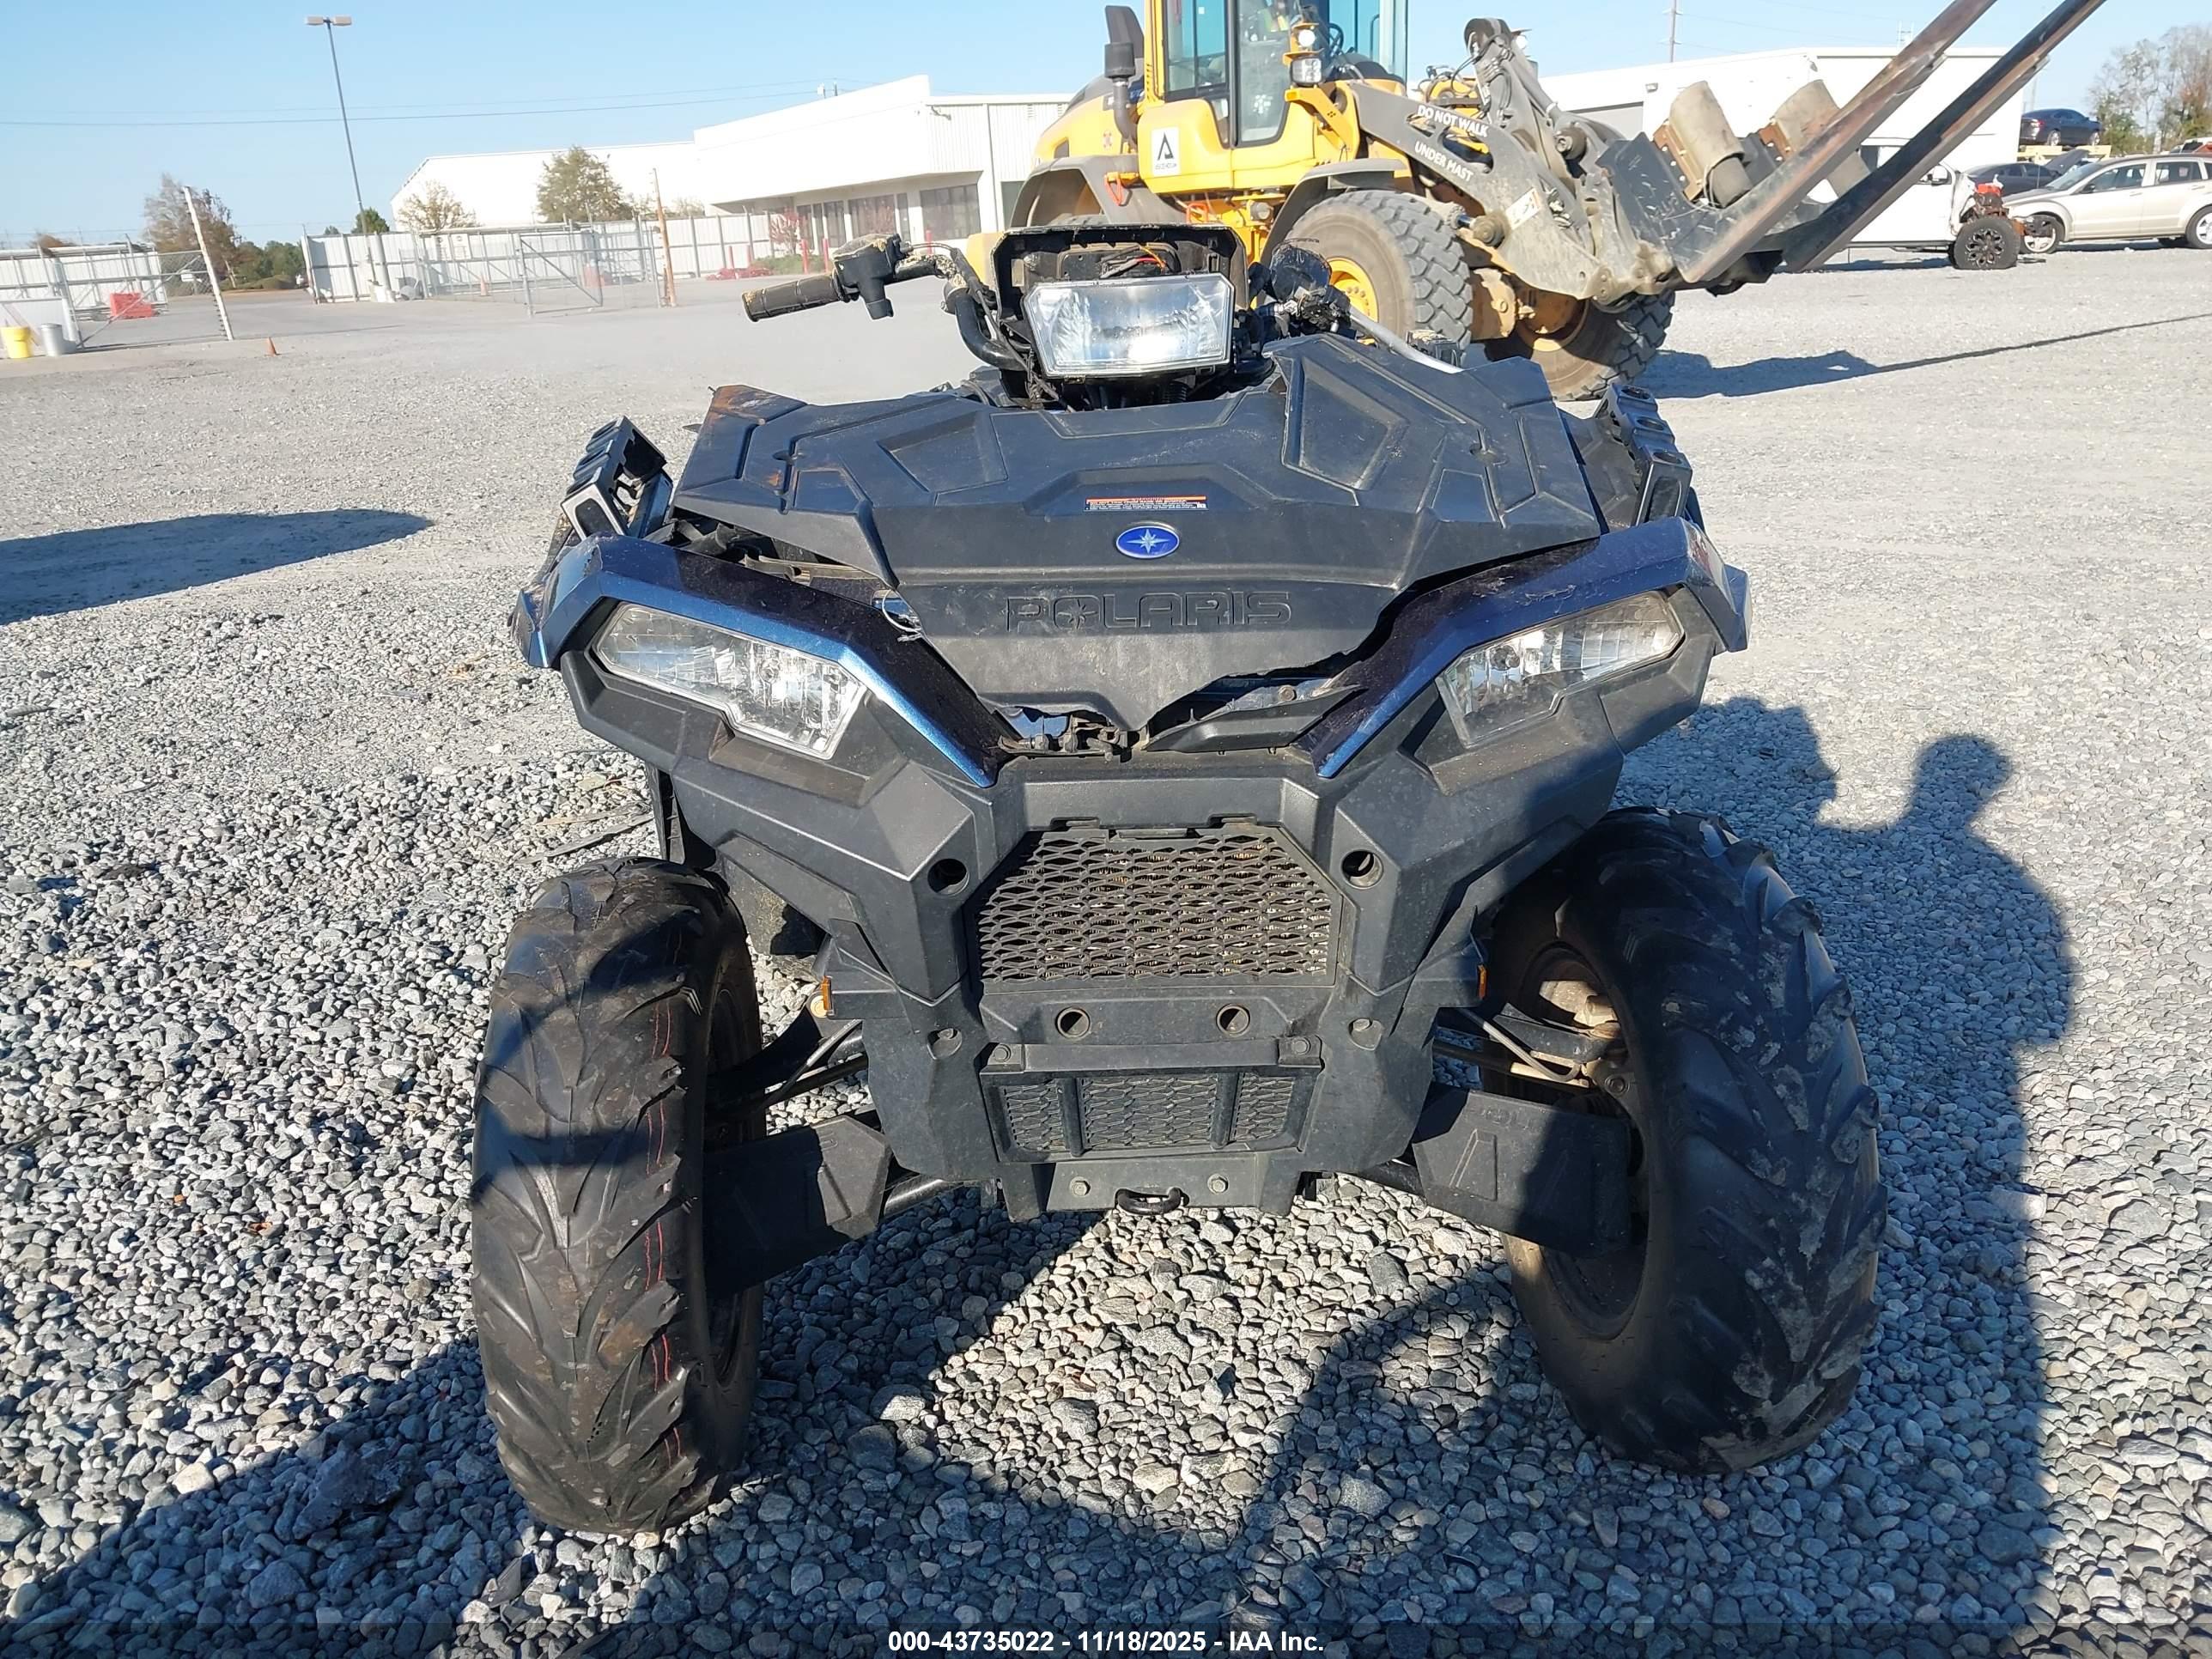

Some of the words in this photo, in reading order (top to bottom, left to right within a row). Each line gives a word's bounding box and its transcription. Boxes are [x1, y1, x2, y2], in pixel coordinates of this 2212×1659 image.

[1418, 105, 1434, 119] DO
[1434, 110, 1458, 127] NOT
[1458, 118, 1489, 137] WALK
[1414, 141, 1447, 167] UNDER
[1446, 160, 1474, 181] MAST
[1006, 592, 1291, 632] POLARIS
